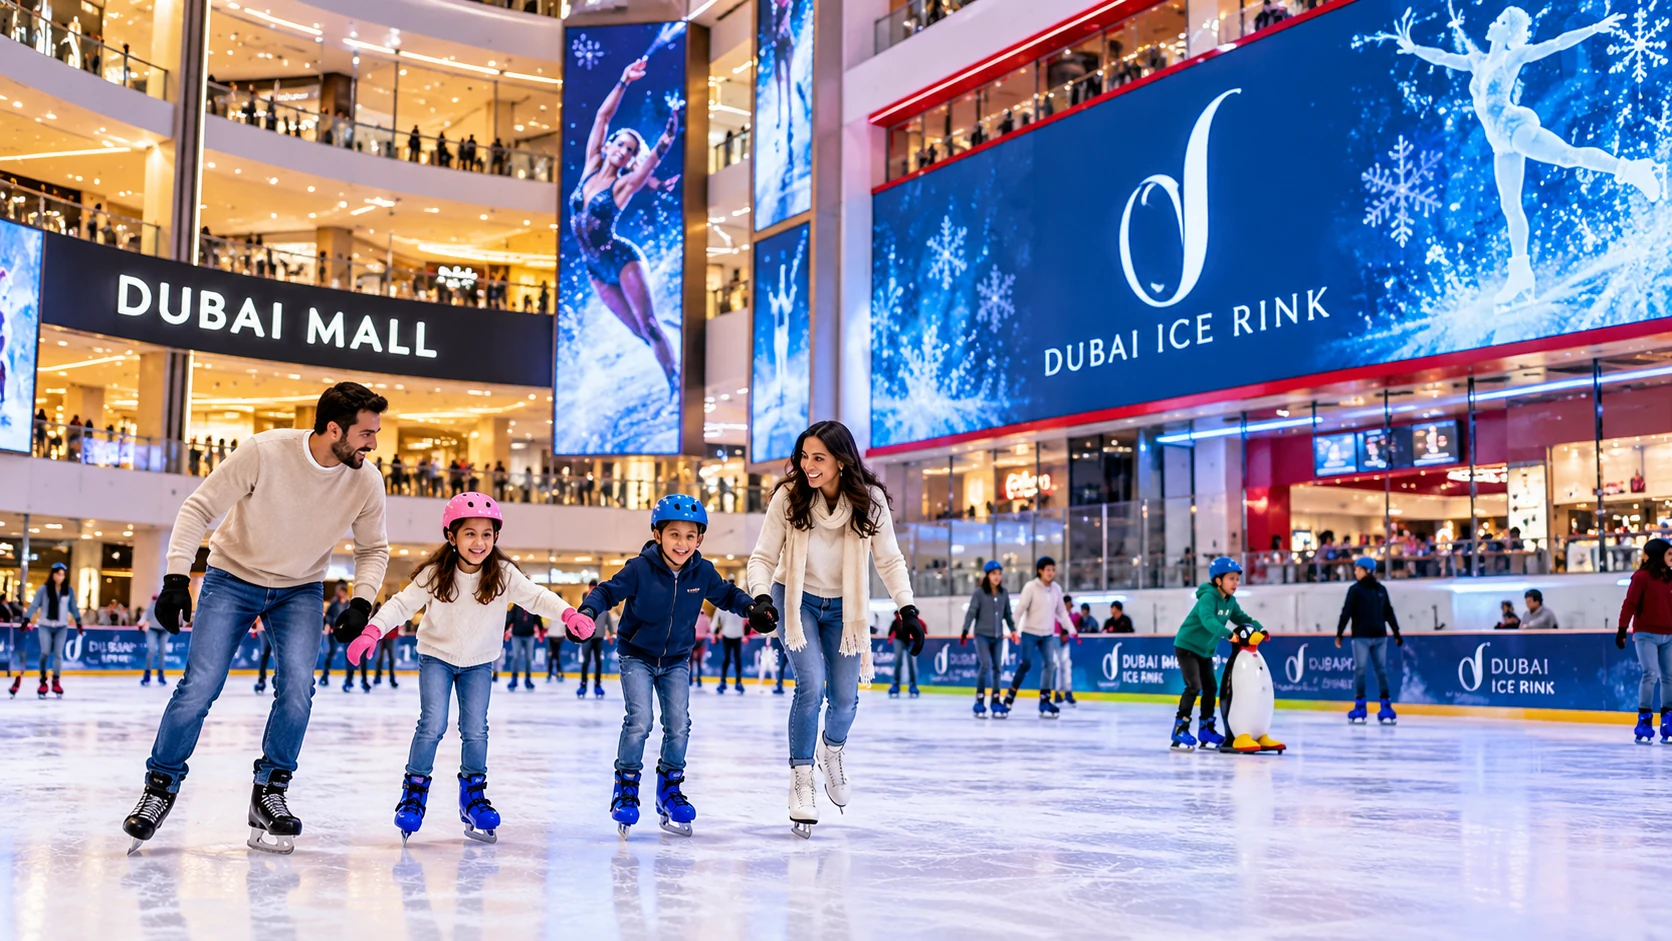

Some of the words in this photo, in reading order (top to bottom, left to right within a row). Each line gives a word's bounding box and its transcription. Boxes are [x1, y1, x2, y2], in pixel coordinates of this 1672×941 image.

[117, 274, 283, 340] DUBAI
[306, 307, 438, 358] MALL
[1044, 329, 1139, 377] DUBAI
[1157, 312, 1213, 353] ICE
[1233, 286, 1330, 337] RINK
[1122, 654, 1158, 669] DUBAI
[1491, 658, 1549, 675] DUBAI
[1122, 671, 1139, 683] ICE
[1491, 678, 1515, 694] ICE
[1519, 680, 1555, 695] RINK
